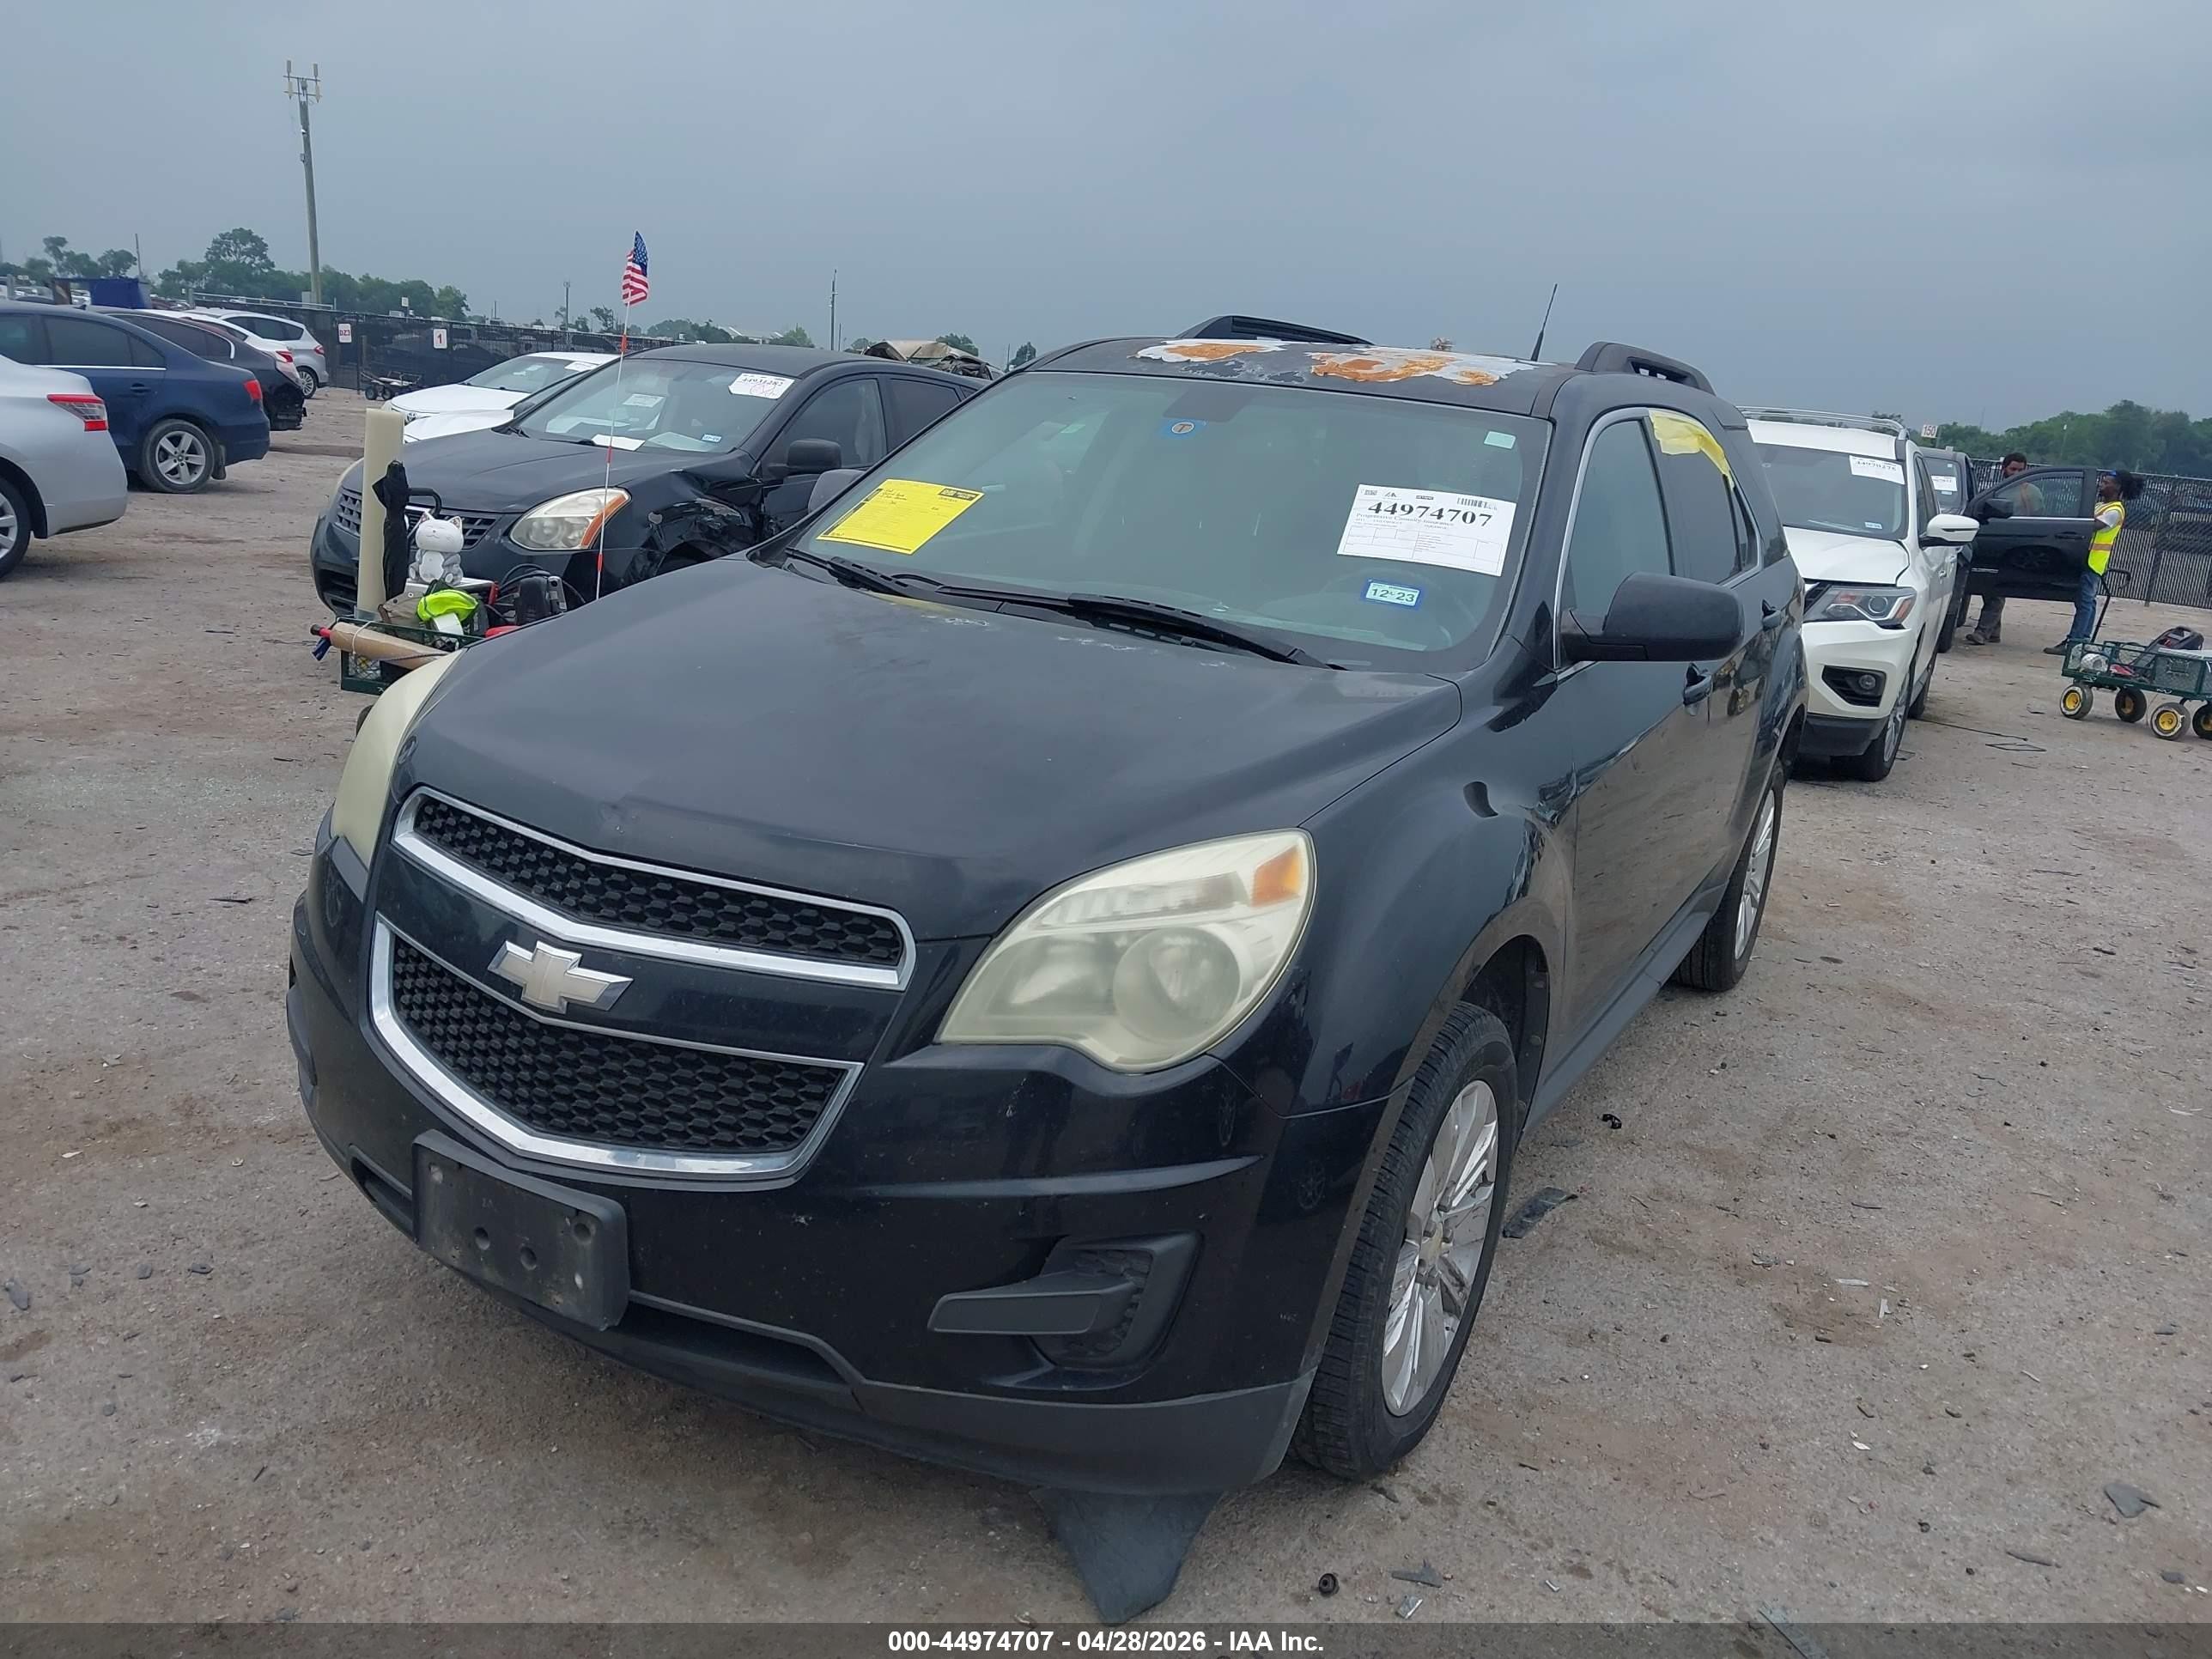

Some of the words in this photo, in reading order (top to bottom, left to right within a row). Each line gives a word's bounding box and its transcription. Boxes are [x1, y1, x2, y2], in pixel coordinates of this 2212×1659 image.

[437, 332, 442, 344] 1
[1923, 425, 1936, 436] 150
[1368, 501, 1492, 527] 44974707
[1372, 588, 1389, 599] 12
[1395, 592, 1415, 603] 23
